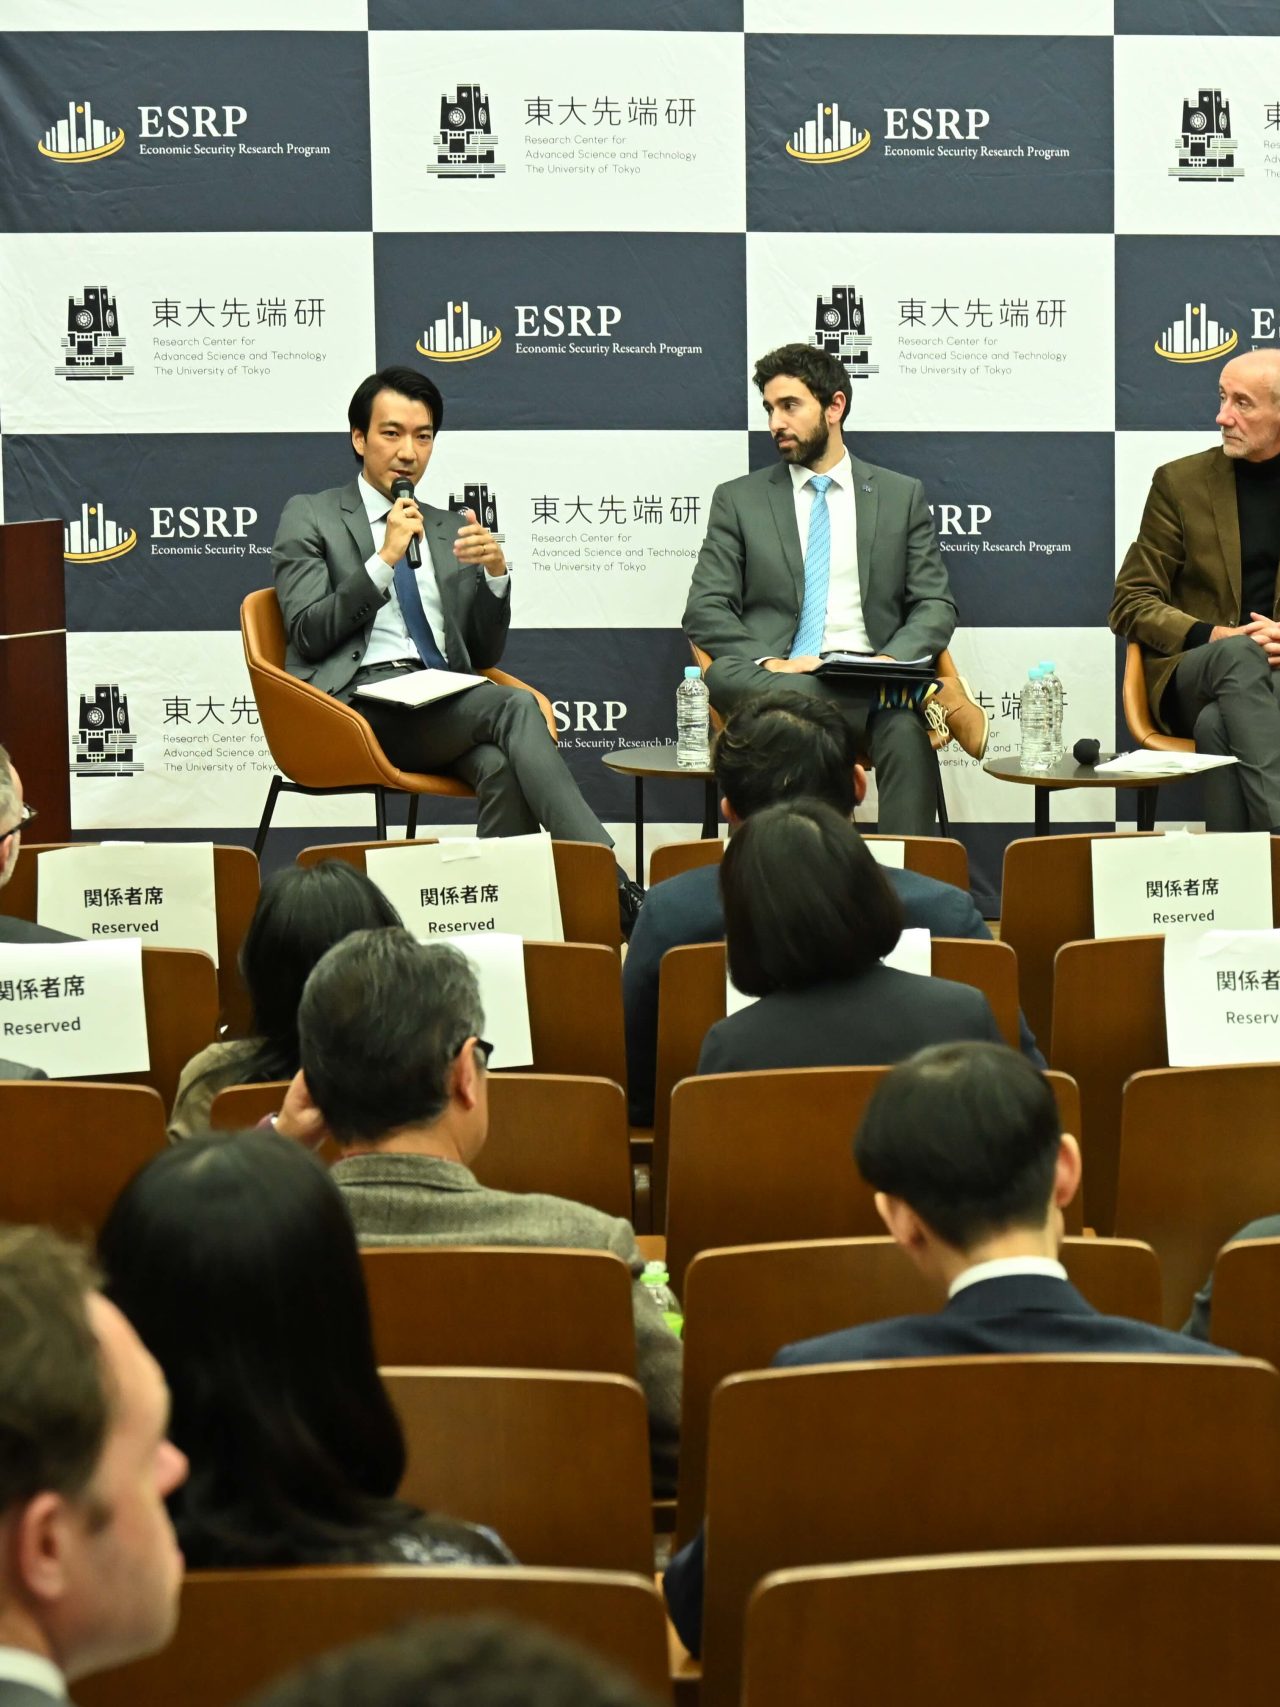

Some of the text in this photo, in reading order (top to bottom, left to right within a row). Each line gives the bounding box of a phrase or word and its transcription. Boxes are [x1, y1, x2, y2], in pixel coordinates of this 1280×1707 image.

[524, 96, 696, 127] 東大先端研
[138, 106, 247, 138] ESRP
[884, 108, 989, 140] ESRP
[525, 135, 626, 144] Research Center for
[140, 143, 330, 157] Economic Security Research Program
[526, 150, 696, 161] Advanced Science and Technology
[884, 146, 1069, 160] Economic Security Research Program
[525, 164, 640, 175] The University of Tokyo
[152, 297, 325, 328] 東大先端研
[898, 298, 1067, 328] 東大先端研
[515, 305, 621, 337] ESRP
[153, 336, 255, 346] Research Center for
[899, 336, 998, 345] Research Center for
[154, 351, 326, 361] Advanced Science and Technology
[516, 342, 702, 357] Economic Security Research Program
[899, 351, 1067, 362] Advanced Science and Technology
[154, 366, 270, 376] The University of Tokyo
[899, 365, 1011, 375] The University of Tokyo
[531, 495, 701, 524] 東大先端研
[150, 507, 257, 538] ESRP
[929, 504, 992, 535] RP
[532, 533, 632, 542] Research Center for
[151, 544, 271, 557] Economic Security Rese
[532, 548, 580, 557] Advanced
[584, 548, 621, 556] Science
[625, 548, 643, 556] and
[940, 541, 1071, 554] Security Research Program
[532, 562, 646, 572] The University of Tokyo
[163, 694, 259, 725] 東大先
[551, 701, 627, 732] SRP
[163, 733, 264, 743] Research Center for
[990, 731, 1000, 739] or
[575, 738, 614, 750] Security
[618, 737, 662, 748] Research
[993, 744, 1011, 753] and
[164, 748, 271, 757] Advanced Science an
[164, 762, 279, 772] The University of Tokyo
[939, 758, 969, 770] versity
[1146, 878, 1218, 898] 関係者席
[84, 886, 163, 908] 関係者席
[420, 884, 498, 907] 関係者席
[1153, 909, 1214, 923] Reserved
[92, 920, 158, 934] Reserved
[429, 918, 494, 933] Reserved
[4, 1017, 81, 1036] Reserved
